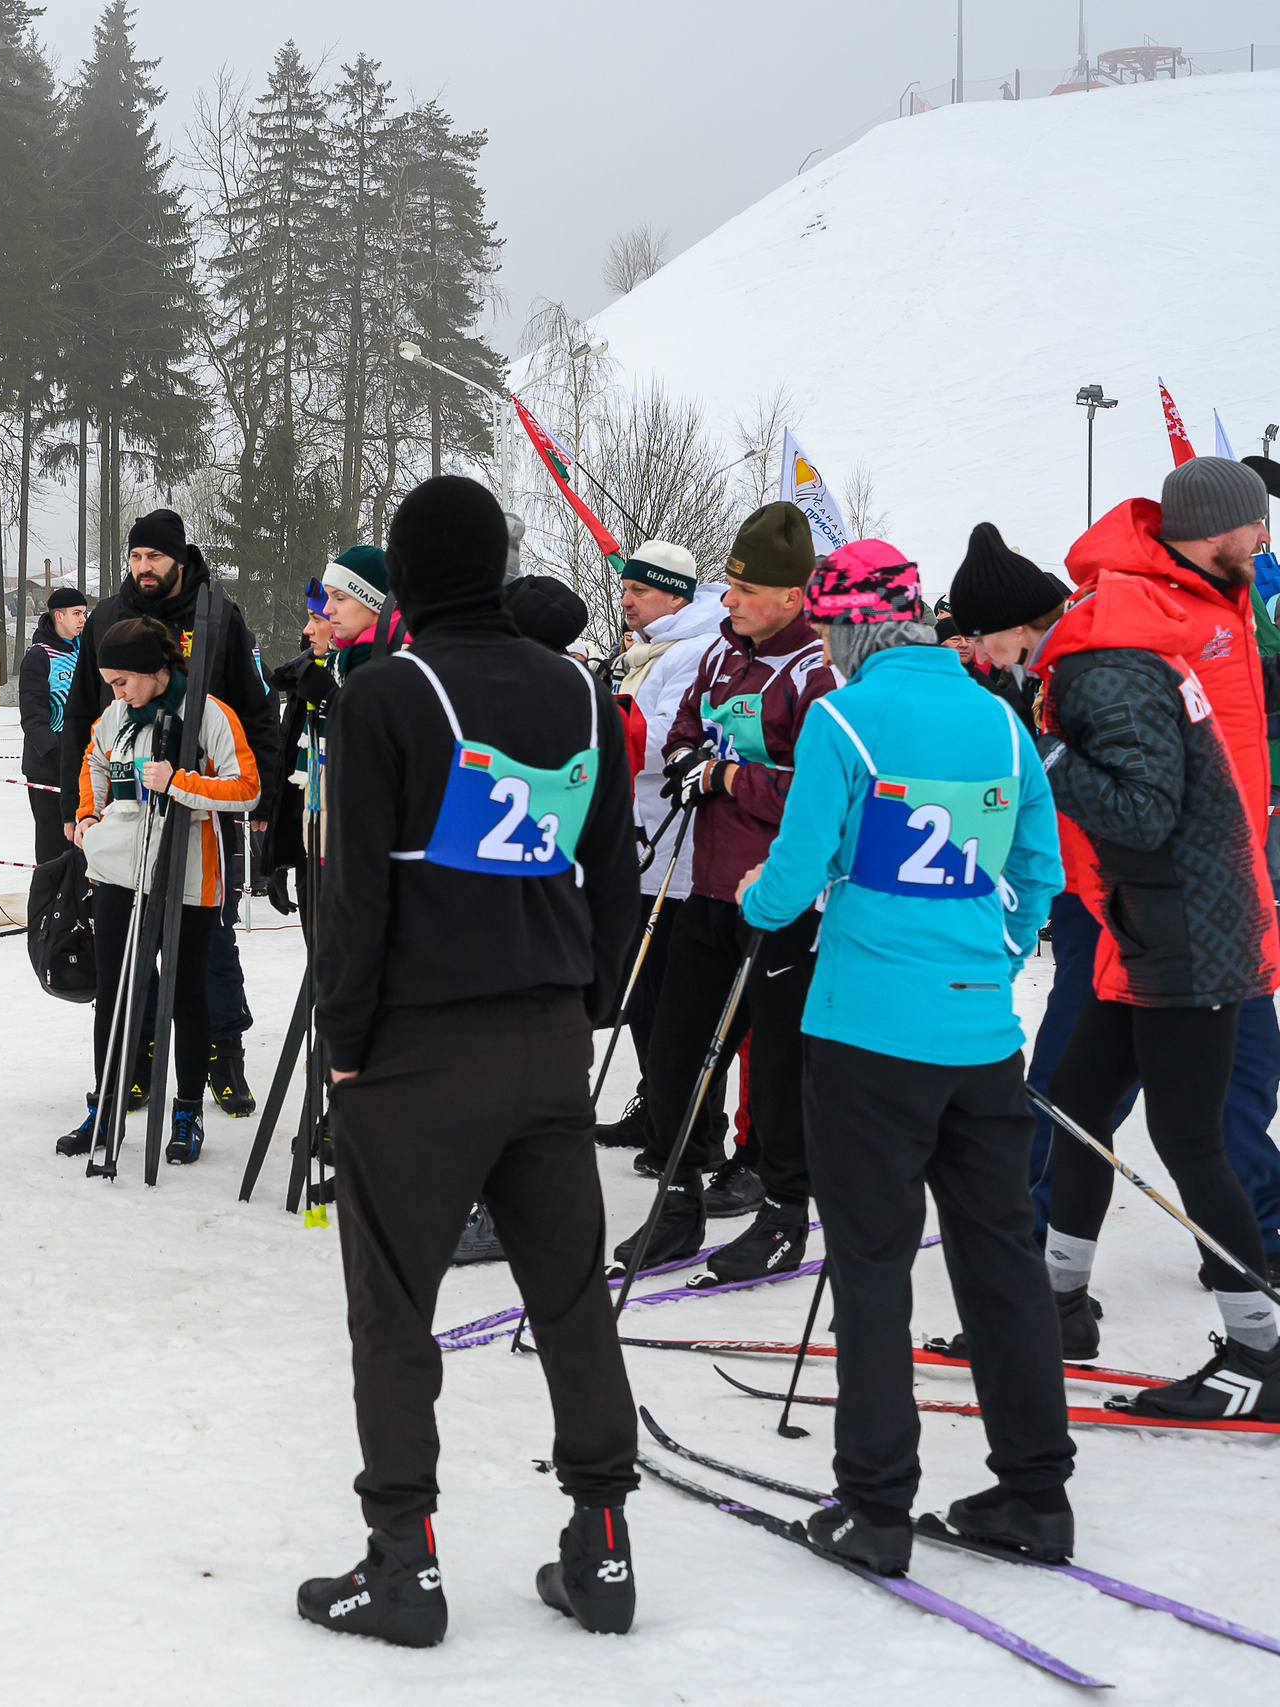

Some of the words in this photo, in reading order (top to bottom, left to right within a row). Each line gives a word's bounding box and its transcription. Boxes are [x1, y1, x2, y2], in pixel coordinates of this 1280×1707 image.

[646, 569, 688, 590] БЕЛАРУСЬ
[476, 776, 560, 863] 2.3
[896, 802, 980, 885] 2.1
[766, 1240, 792, 1269] alpina
[329, 1590, 372, 1618] alpina
